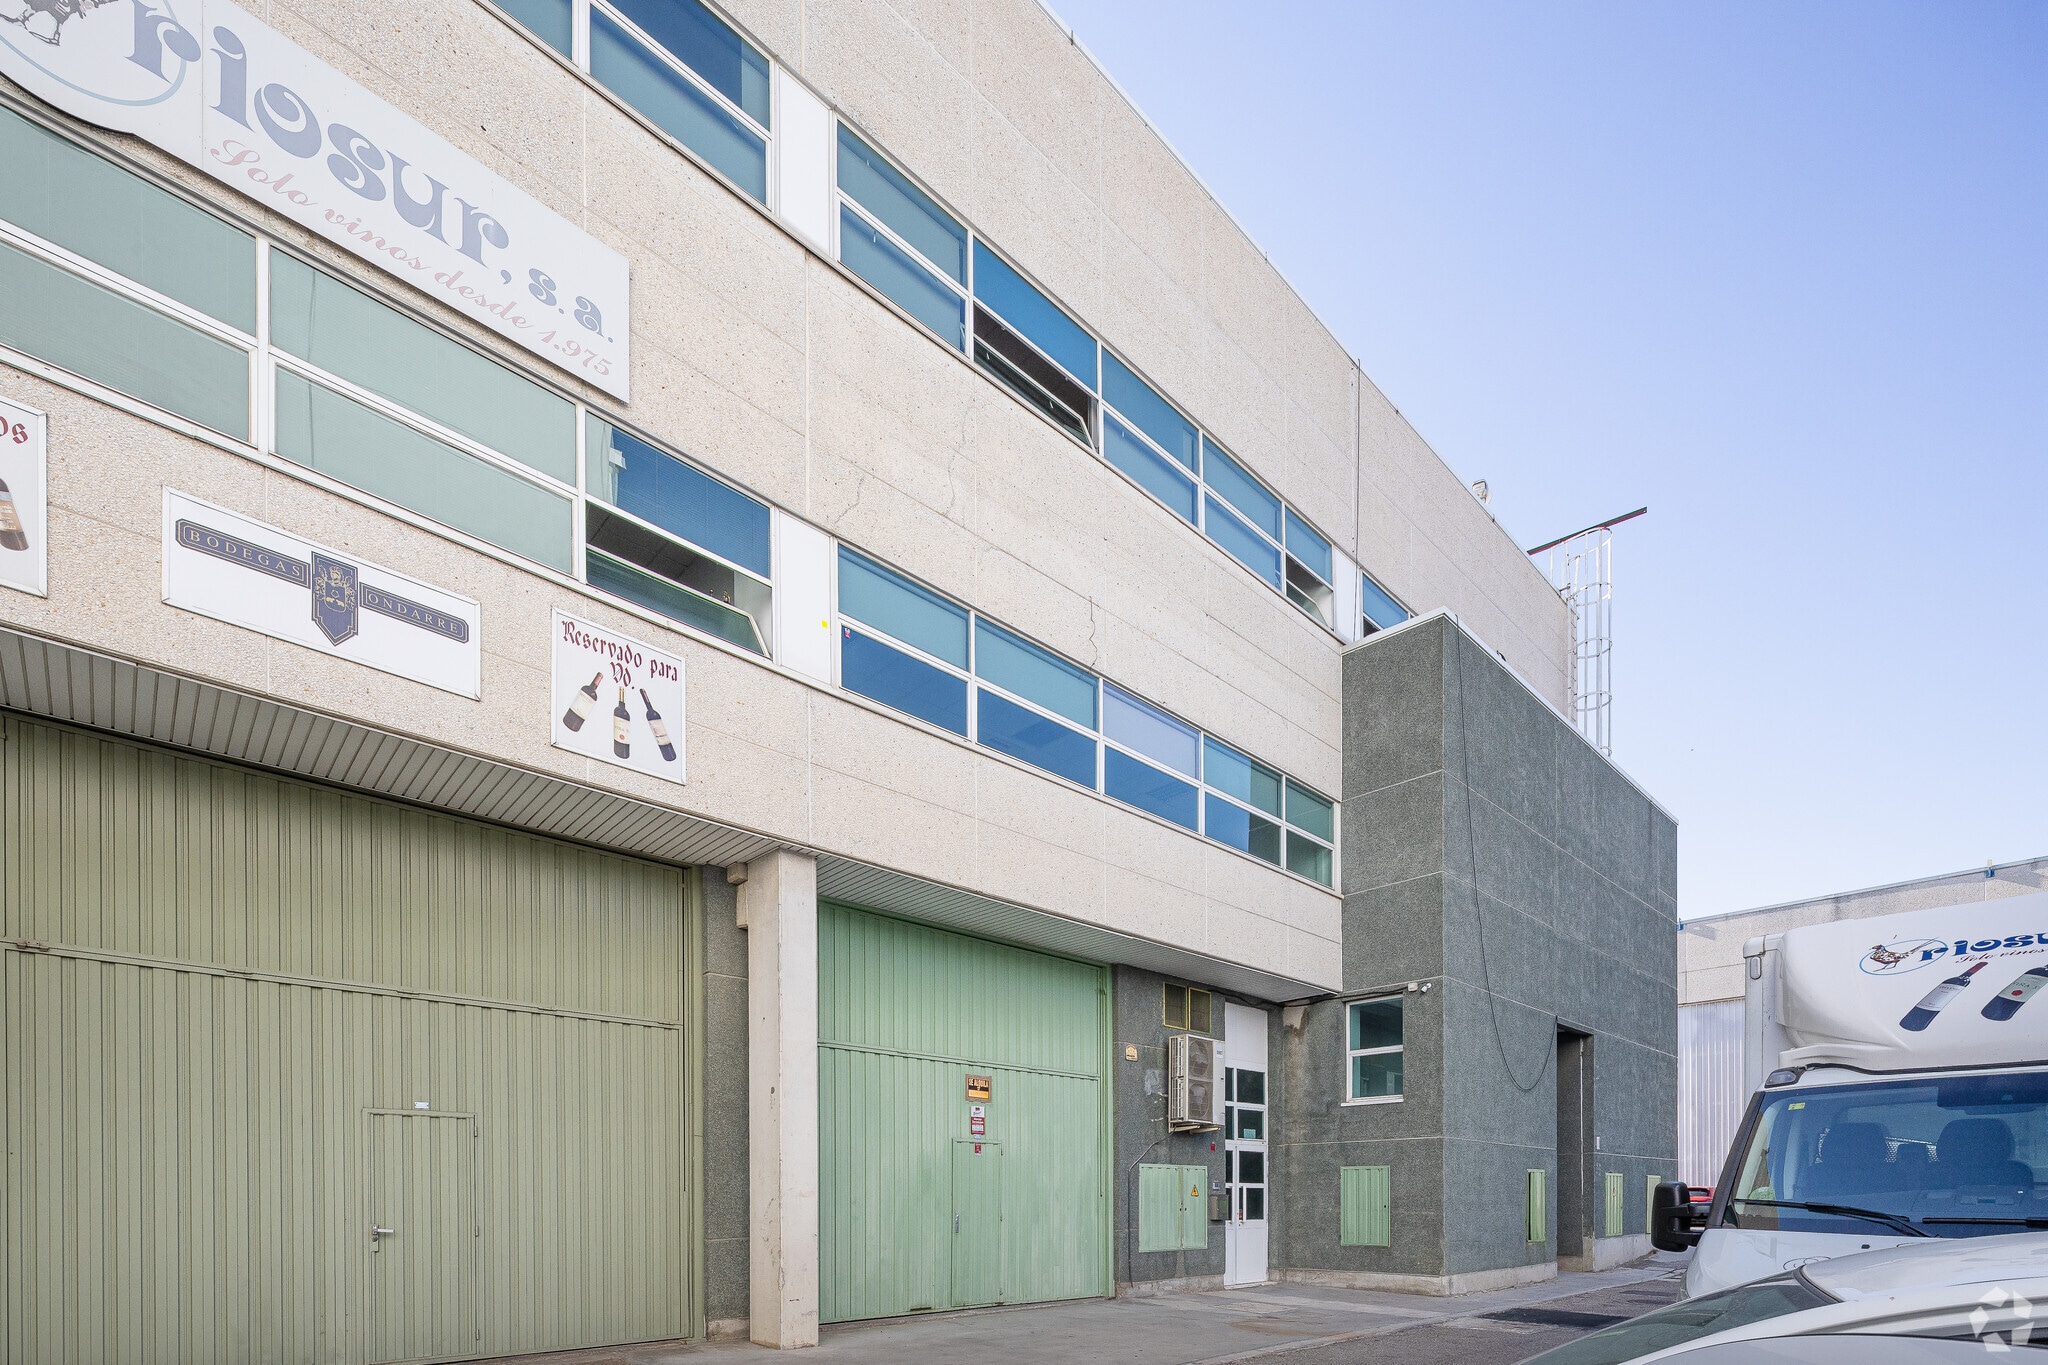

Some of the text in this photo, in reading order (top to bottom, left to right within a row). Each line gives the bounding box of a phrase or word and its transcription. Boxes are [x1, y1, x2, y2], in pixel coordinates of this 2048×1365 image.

[210, 139, 614, 377] Solo vinos desde 1.975
[189, 529, 459, 634] BODEGAS ONDARRE
[561, 620, 678, 682] Reservado para
[1955, 952, 1996, 964] Solo
